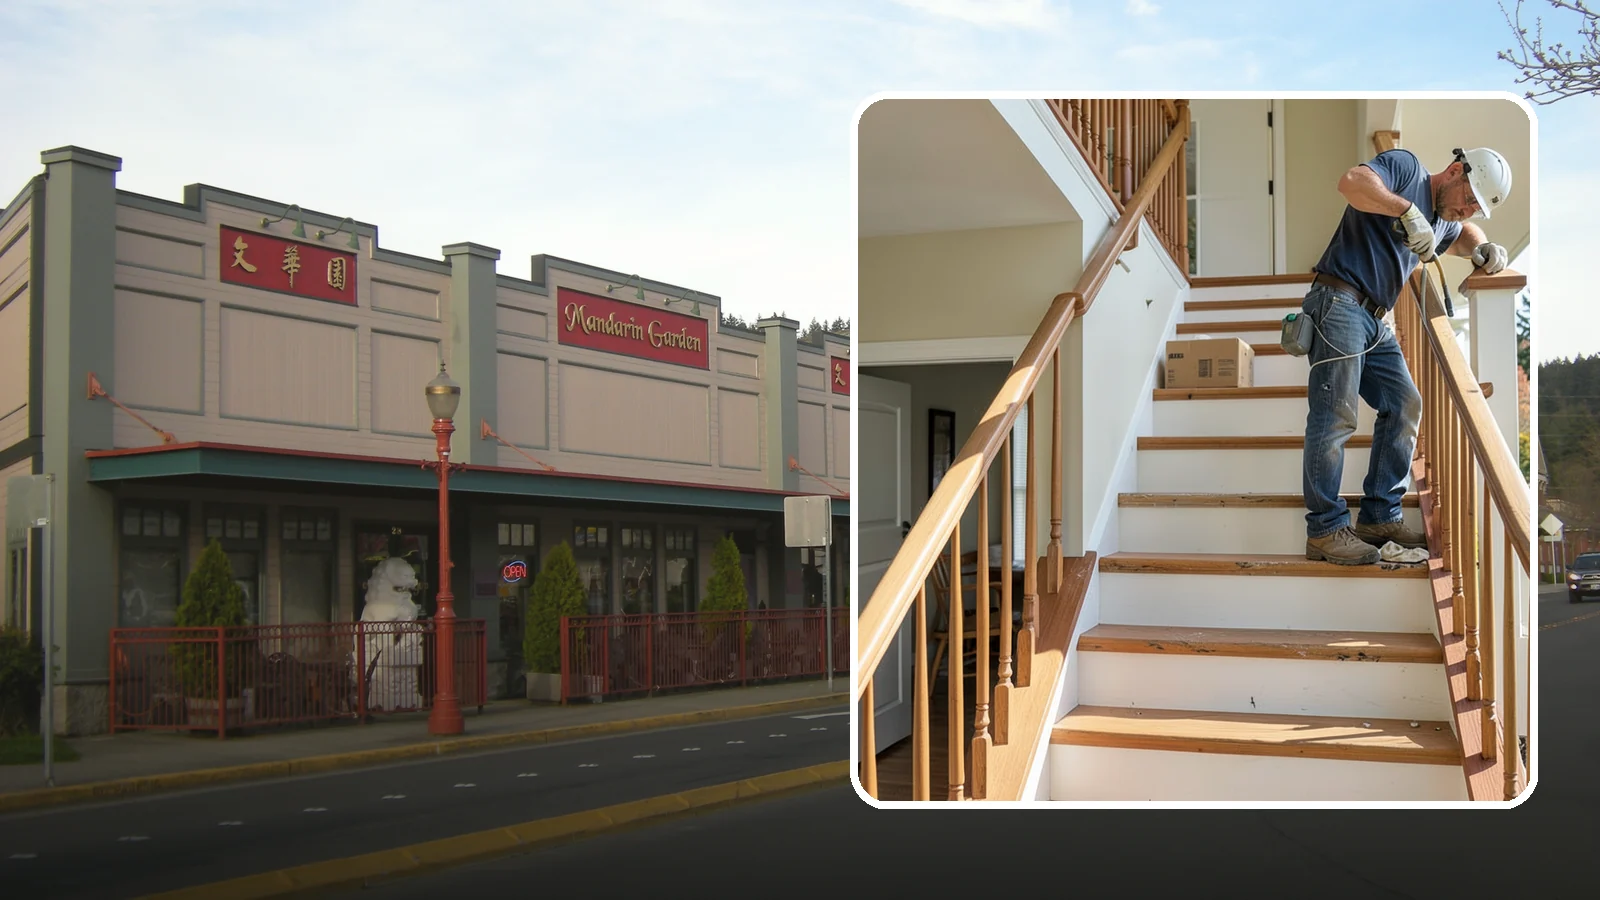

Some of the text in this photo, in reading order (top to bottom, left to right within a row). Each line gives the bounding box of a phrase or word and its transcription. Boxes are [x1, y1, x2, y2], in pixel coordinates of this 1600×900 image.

[231, 236, 346, 290] 文華園
[565, 302, 701, 352] Mandarin Garden
[503, 565, 527, 578] OPEN
